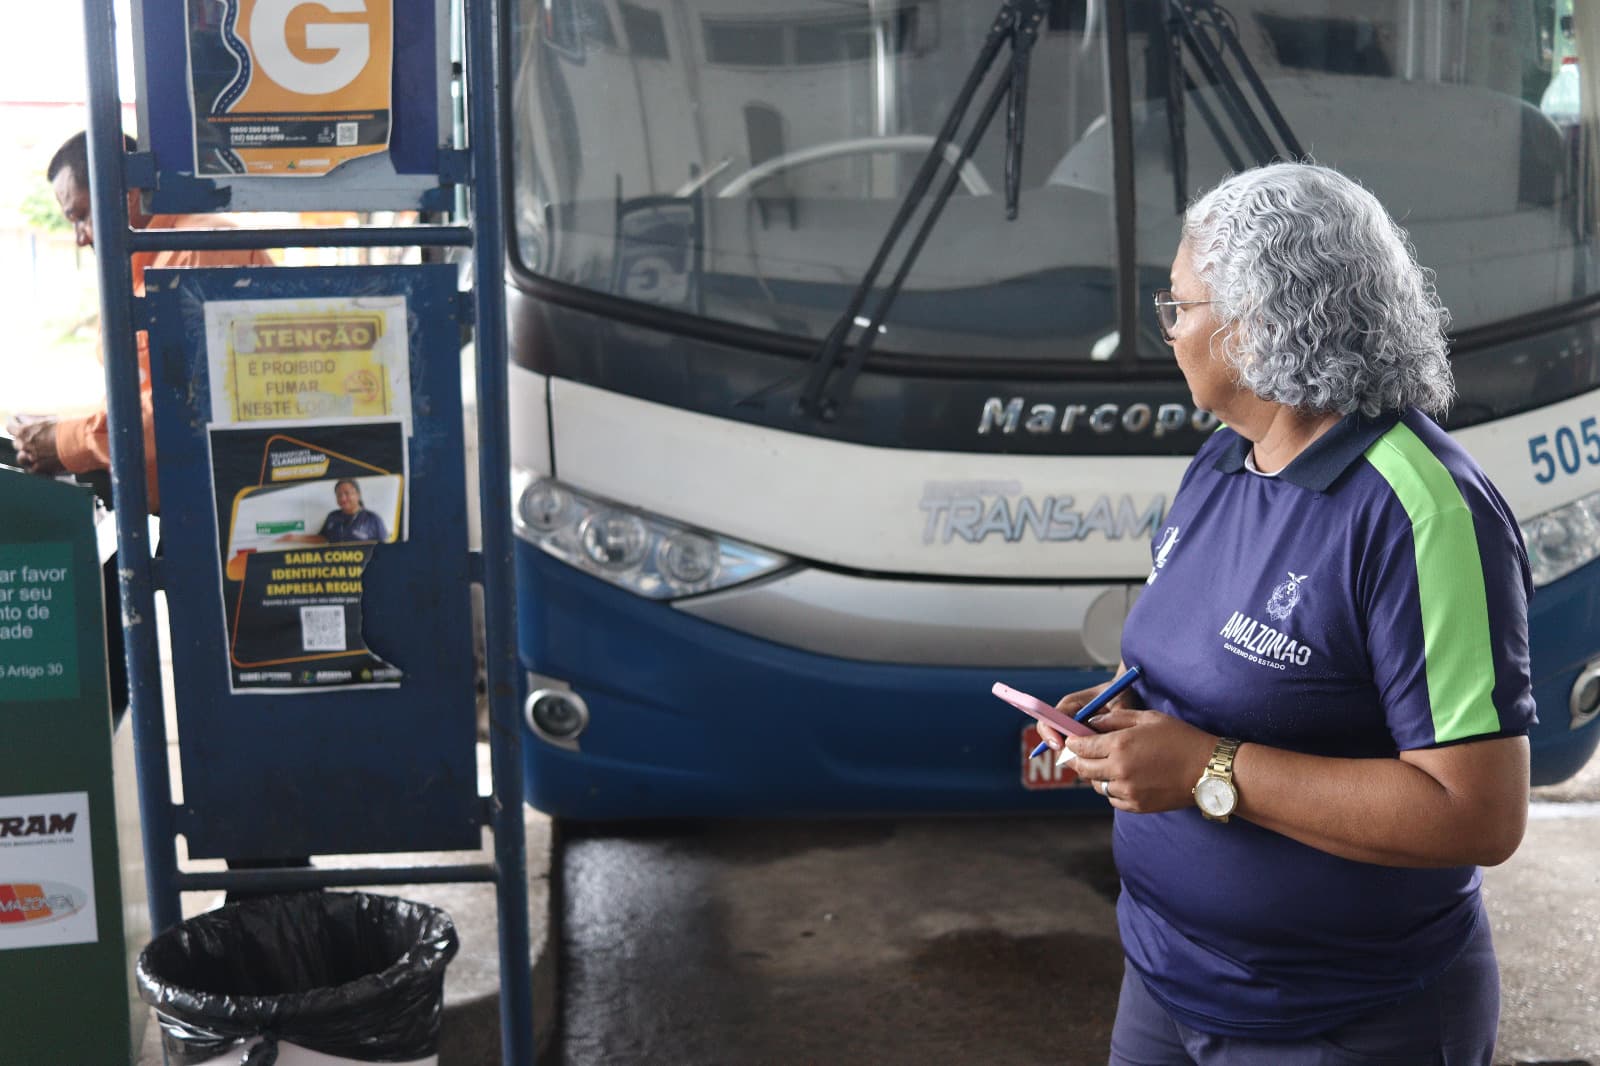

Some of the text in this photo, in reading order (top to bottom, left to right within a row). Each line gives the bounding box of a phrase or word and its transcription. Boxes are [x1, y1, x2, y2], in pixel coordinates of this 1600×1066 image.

[249, 0, 370, 95] G
[262, 358, 336, 375] PROIBIDO
[265, 380, 319, 396] FUMAR
[243, 401, 292, 417] NESTE
[1528, 417, 1600, 484] 505
[285, 551, 364, 564] SAIBA COMO
[22, 566, 67, 582] favor
[271, 566, 346, 579] IDENTIFICAR
[20, 587, 52, 601] seu
[266, 583, 323, 595] EMPRESA
[27, 603, 50, 620] de
[0, 622, 33, 639] ade
[1223, 642, 1286, 671] GOVERNO DO ESTADO
[8, 664, 45, 679] Artigo
[47, 662, 64, 676] 30
[0, 812, 77, 837] RAM
